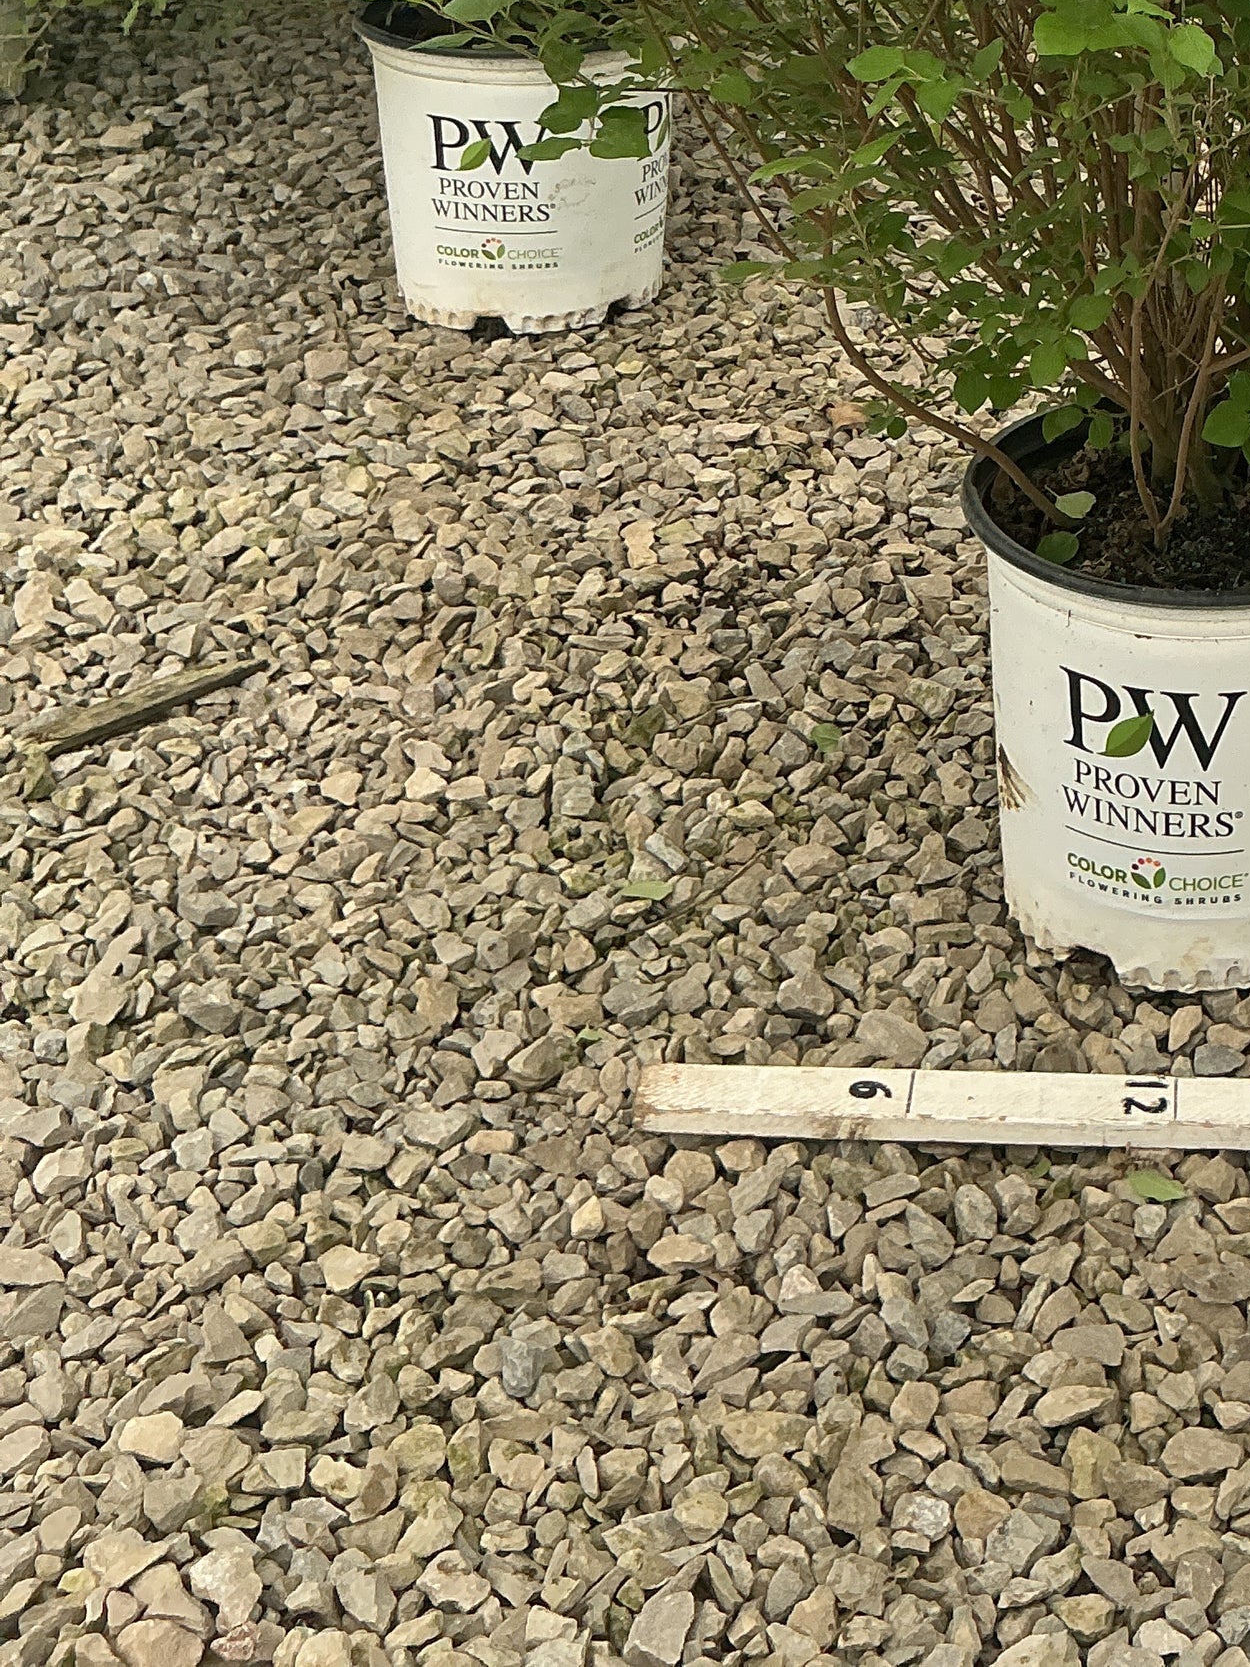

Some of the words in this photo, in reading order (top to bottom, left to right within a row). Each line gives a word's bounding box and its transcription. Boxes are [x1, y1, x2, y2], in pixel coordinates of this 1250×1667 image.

[426, 114, 549, 175] PW
[438, 177, 539, 200] PROVEN
[436, 244, 479, 260] COLOR
[508, 247, 561, 260] CHOICE
[1059, 665, 1248, 772] PW
[1074, 758, 1221, 806] PROVEN
[1067, 852, 1128, 885] COLOR
[1169, 873, 1245, 892] CHOICE
[1069, 871, 1163, 905] FLOWERING
[1174, 893, 1242, 905] SHRUBS
[849, 1080, 892, 1099] 6
[1123, 1079, 1169, 1115] 12
